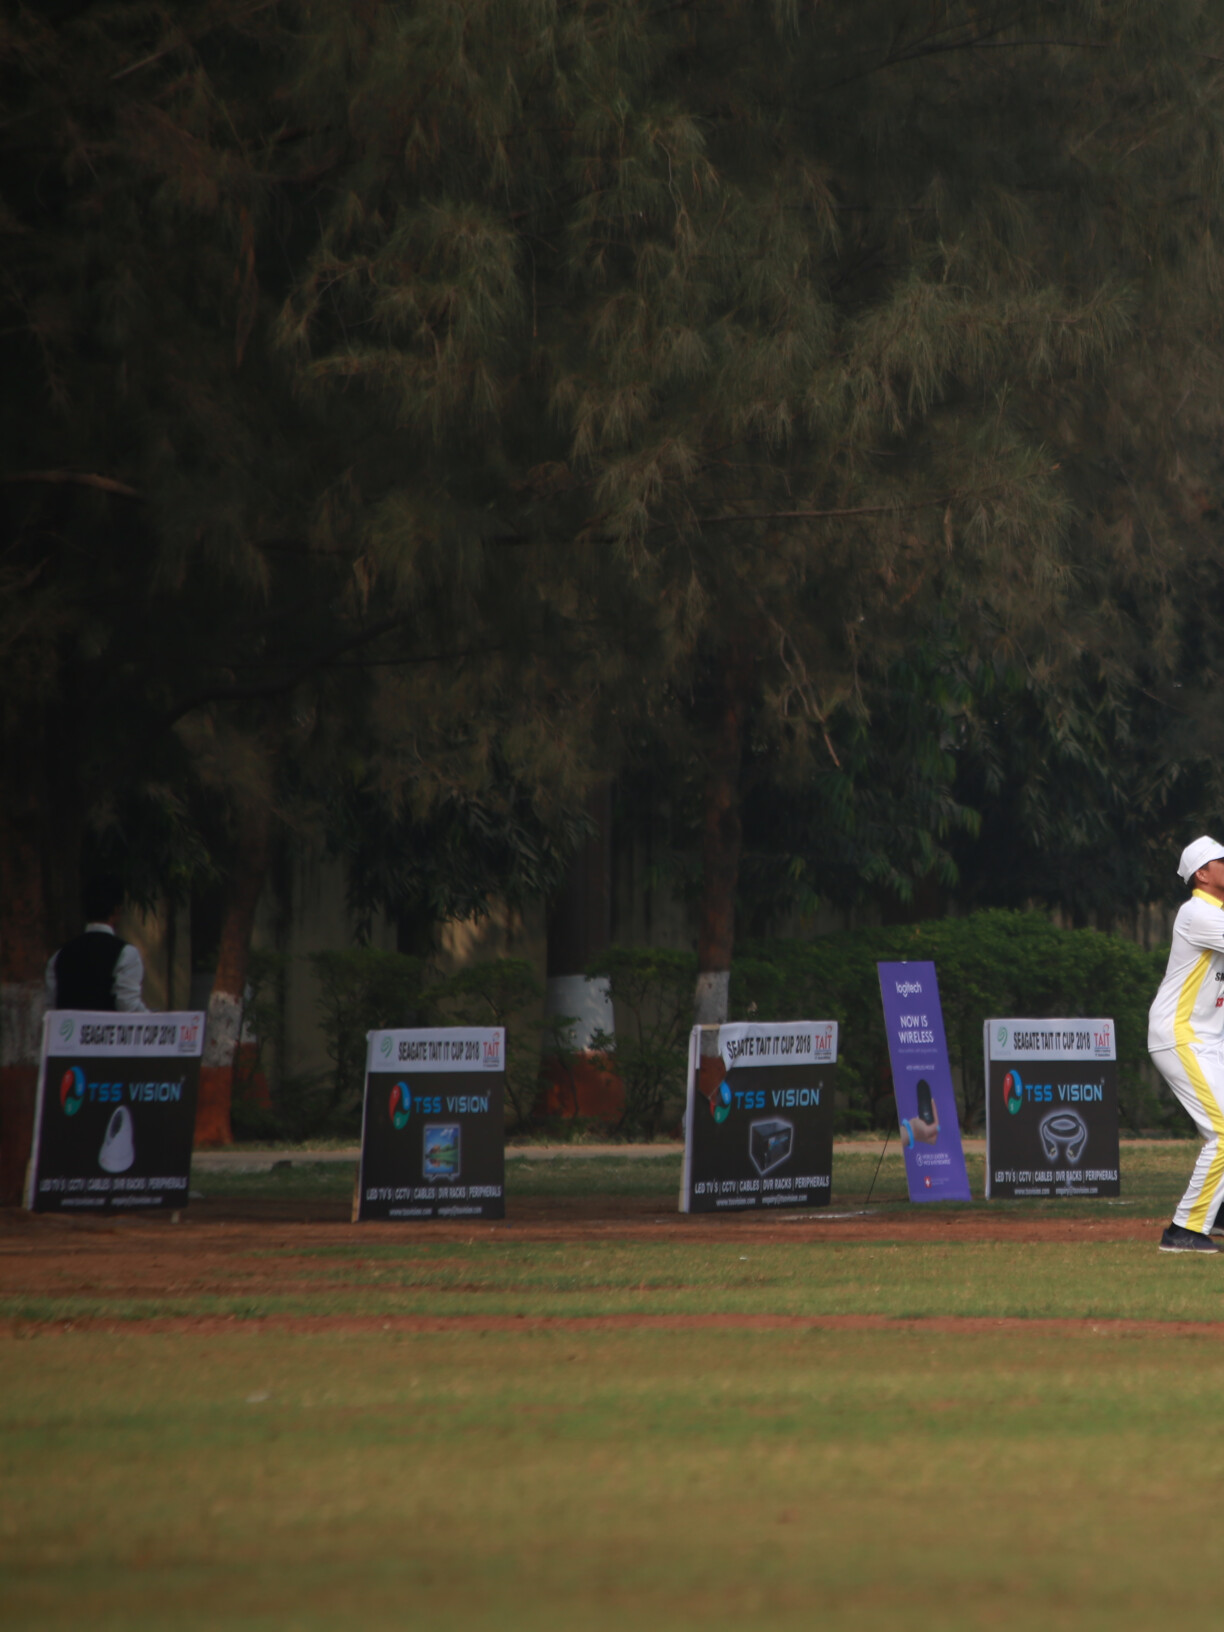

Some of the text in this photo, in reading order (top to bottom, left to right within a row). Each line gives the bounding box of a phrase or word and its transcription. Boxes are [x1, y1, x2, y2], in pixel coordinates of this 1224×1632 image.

[896, 982, 922, 998] logitech
[900, 1016, 928, 1028] NOW IS
[756, 1036, 771, 1055] TAIT
[773, 1036, 781, 1054] IT
[781, 1035, 794, 1054] CUP
[796, 1034, 811, 1053] 2018
[815, 1035, 832, 1049] TAIT
[899, 1031, 934, 1043] WIRELESS
[1014, 1032, 1090, 1050] SEAGATE TAIT IT CUP 2018
[1094, 1033, 1110, 1046] TAIT
[398, 1041, 479, 1061] SEAGATE TAIT IT CUP 2018
[483, 1042, 499, 1057] TAIT
[88, 1083, 182, 1102] TSS VISION
[735, 1089, 820, 1109] TSS VISION
[1025, 1085, 1103, 1102] TSS VISION
[414, 1096, 488, 1113] TSS VISION
[695, 1176, 829, 1193] LED TV'S CCTV CABLES DVR RACKS PERIPHERALS
[995, 1170, 1117, 1182] LED TV'S CCTV CABLES DVR RACKS PERIPHERALS
